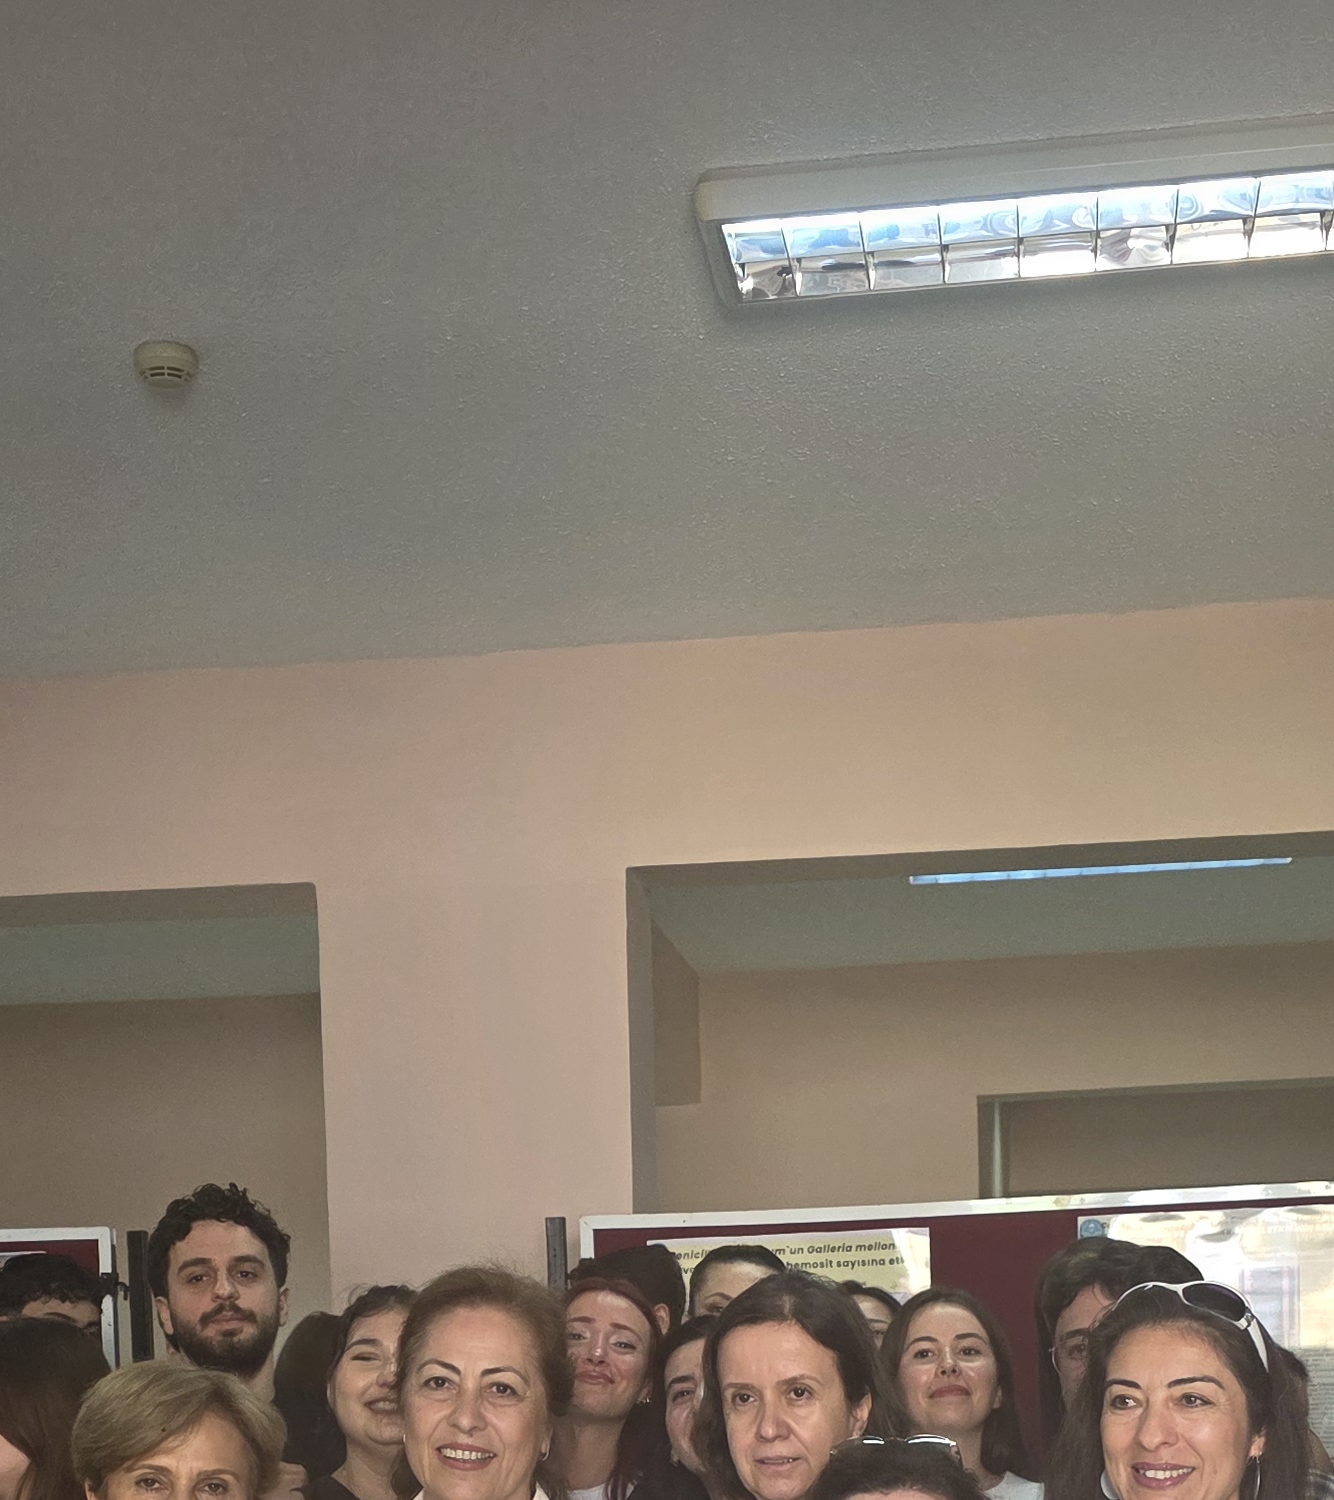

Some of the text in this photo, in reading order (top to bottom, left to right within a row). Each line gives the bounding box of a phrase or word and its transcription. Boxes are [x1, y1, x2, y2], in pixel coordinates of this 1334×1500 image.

[807, 1243, 852, 1254] Galleria
[855, 1241, 896, 1252] mellon
[836, 1259, 886, 1270] sayısına
